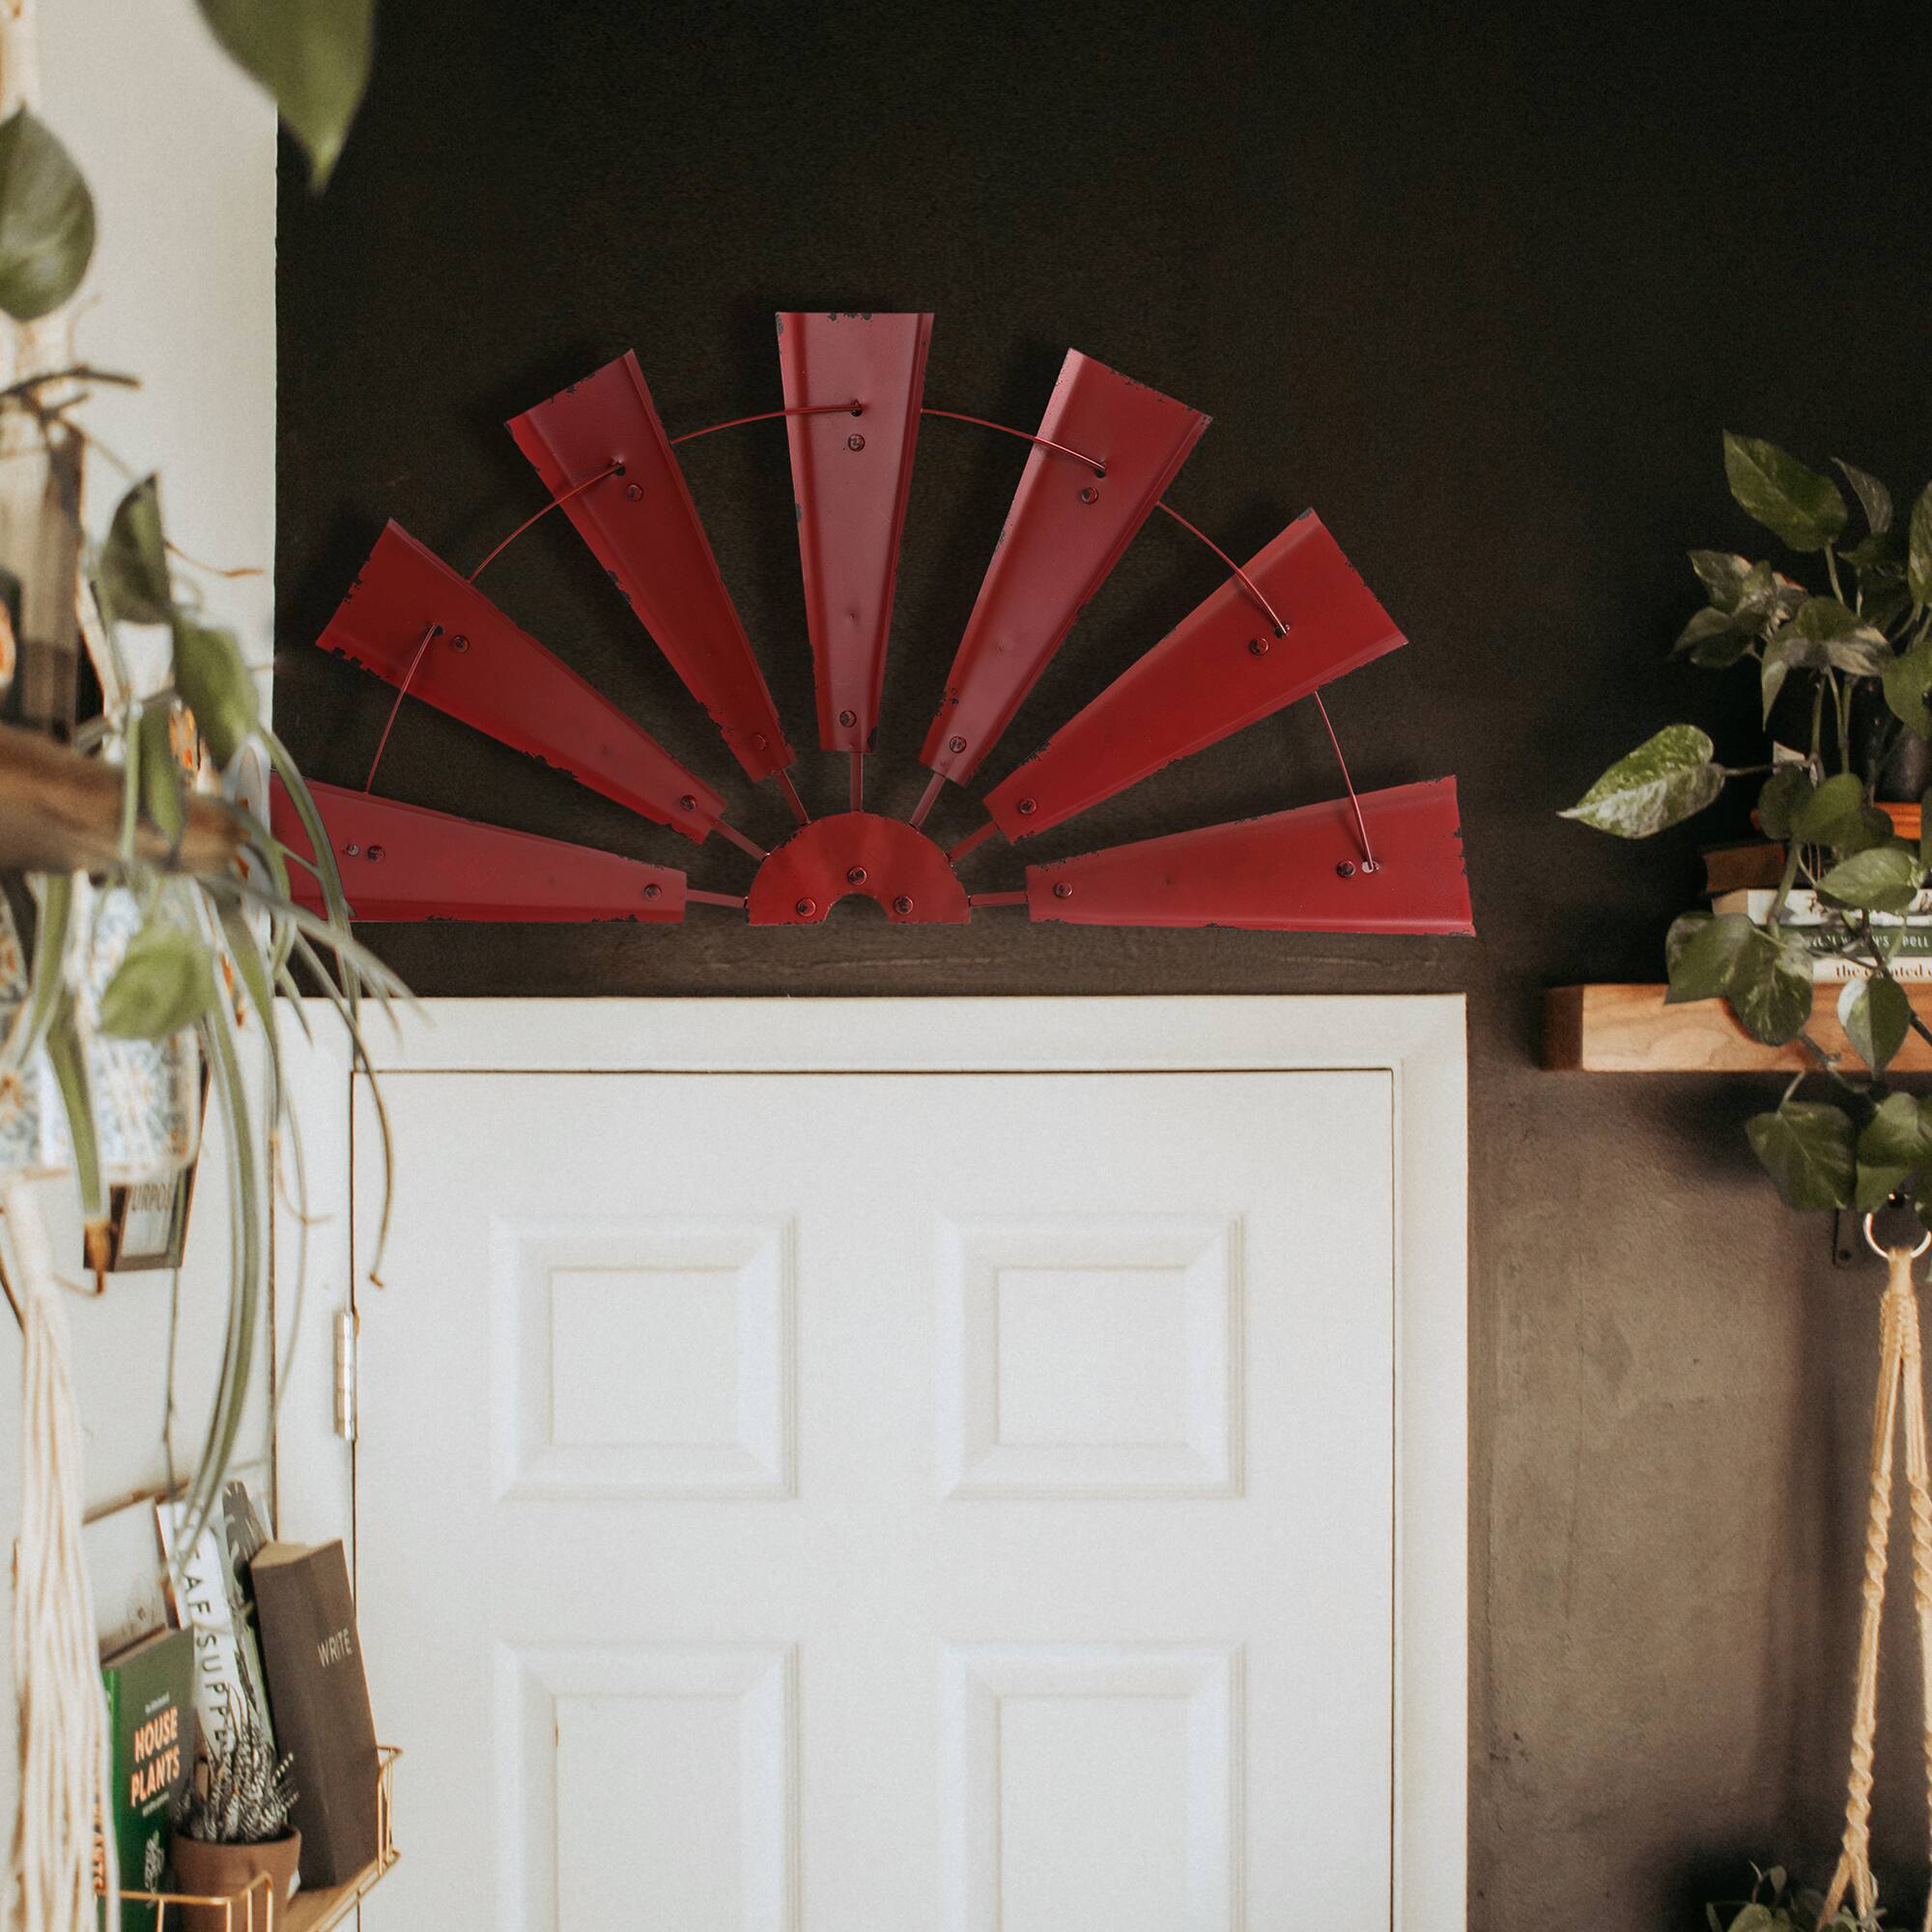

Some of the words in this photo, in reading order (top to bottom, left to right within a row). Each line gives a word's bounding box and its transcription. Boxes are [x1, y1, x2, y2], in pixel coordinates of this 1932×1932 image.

[1835, 964, 1860, 978] the
[317, 1628, 353, 1668] WRITE
[134, 1705, 178, 1763] HOUSE
[130, 1744, 181, 1808] PLANTS
